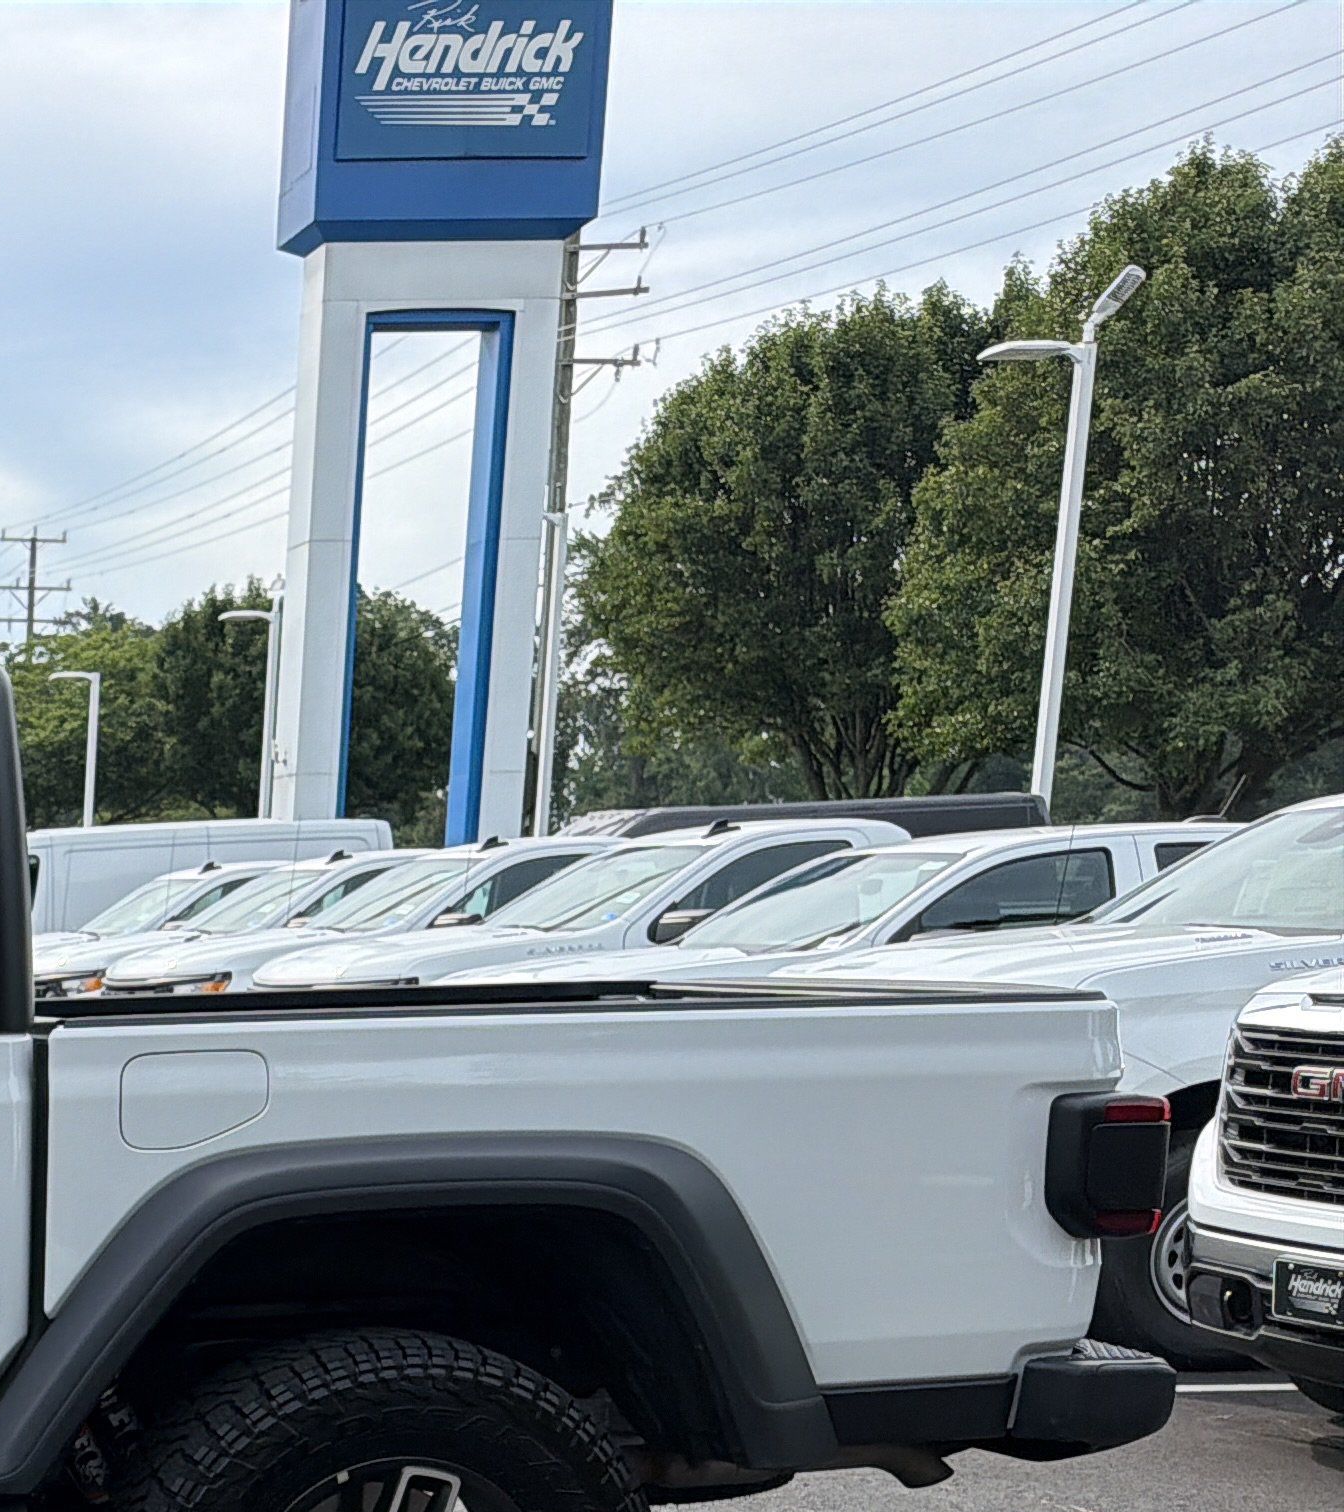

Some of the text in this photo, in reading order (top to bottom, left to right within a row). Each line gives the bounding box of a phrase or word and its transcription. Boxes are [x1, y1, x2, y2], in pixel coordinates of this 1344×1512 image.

[355, 19, 585, 91] Hendrick
[391, 76, 565, 92] CHEVROLET BUICK GMC
[1287, 1273, 1344, 1299] Hendrick
